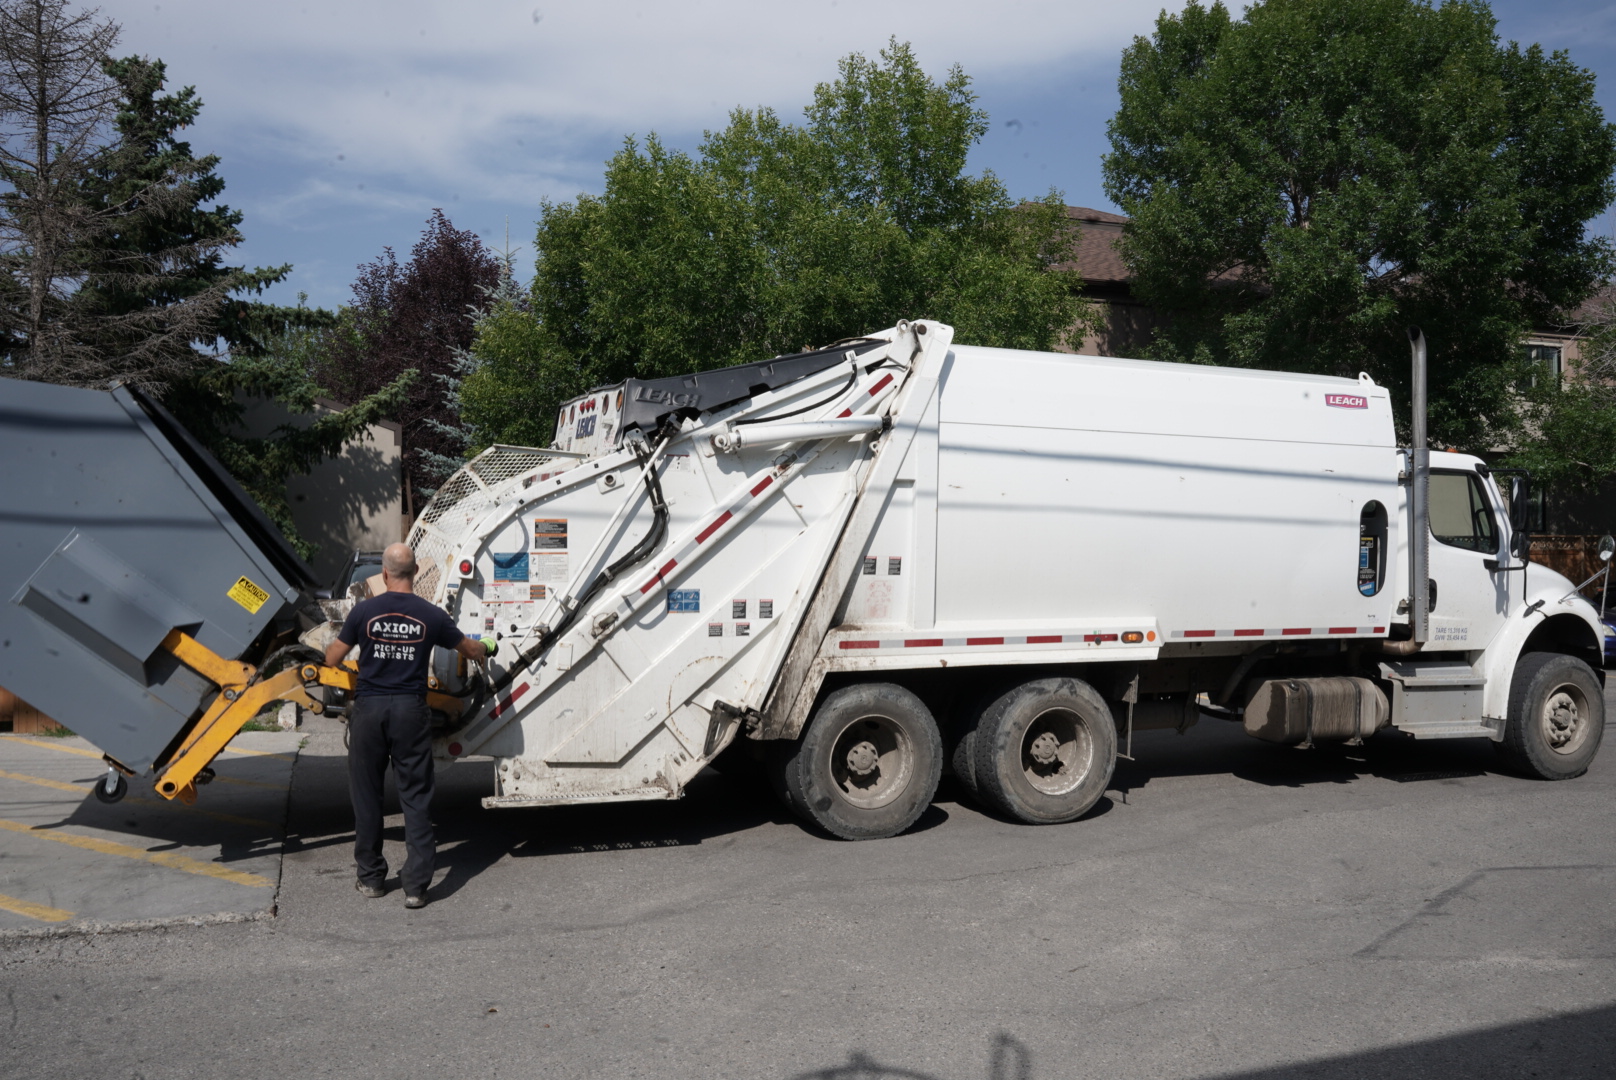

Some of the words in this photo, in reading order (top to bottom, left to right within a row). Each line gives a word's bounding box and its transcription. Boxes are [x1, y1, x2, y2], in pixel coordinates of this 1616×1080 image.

[635, 386, 701, 408] LEACH
[1329, 396, 1363, 406] LEACH
[575, 414, 597, 440] LEACH
[246, 582, 267, 602] CAUTION
[372, 622, 420, 634] AXIOM
[374, 644, 415, 654] PICK-UP
[374, 650, 414, 660] ARTISTS
